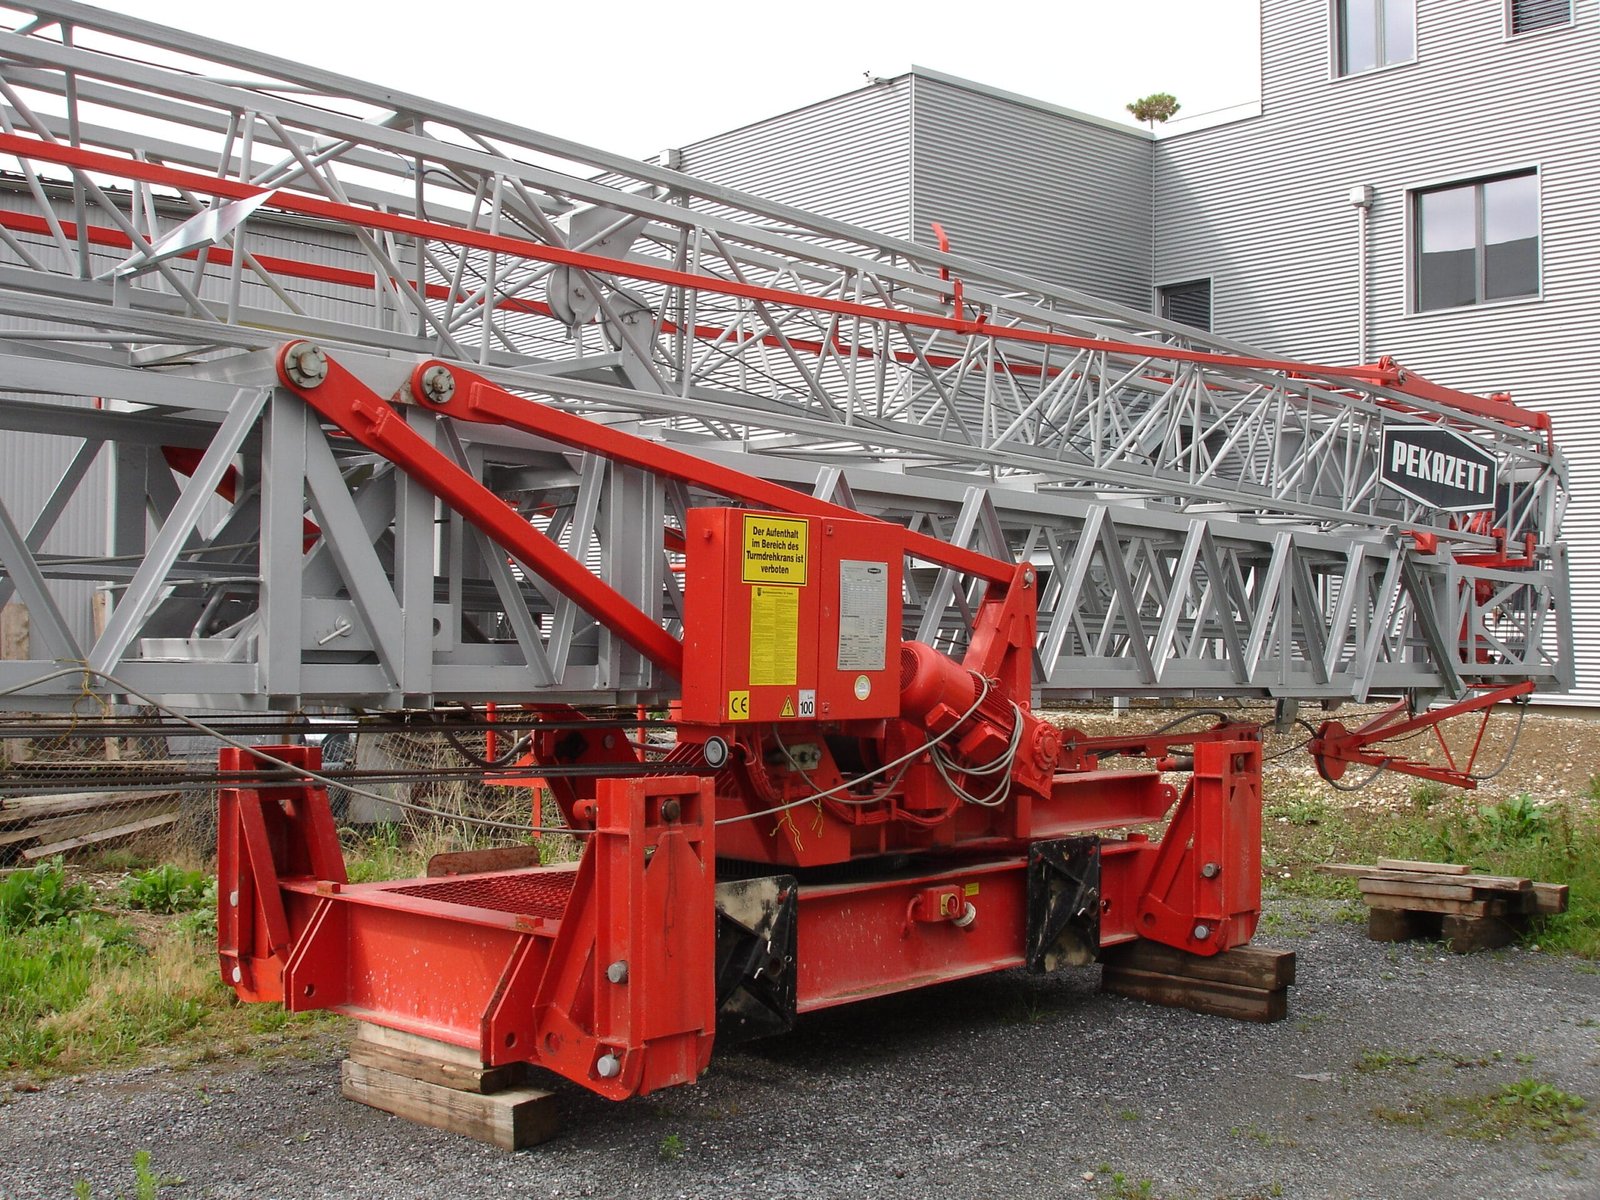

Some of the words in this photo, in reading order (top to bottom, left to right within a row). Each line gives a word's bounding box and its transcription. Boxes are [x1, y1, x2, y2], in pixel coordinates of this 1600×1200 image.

[1392, 440, 1488, 494] PEKAZETT
[753, 526, 764, 536] Der
[766, 528, 798, 538] Aufenthalt
[752, 538, 760, 548] im
[762, 539, 786, 550] Bereich
[788, 541, 798, 550] des
[746, 550, 794, 562] Turmdrehkrans
[796, 554, 804, 562] ist
[761, 564, 789, 574] verboten
[732, 697, 747, 713] CE
[800, 701, 813, 714] 100
